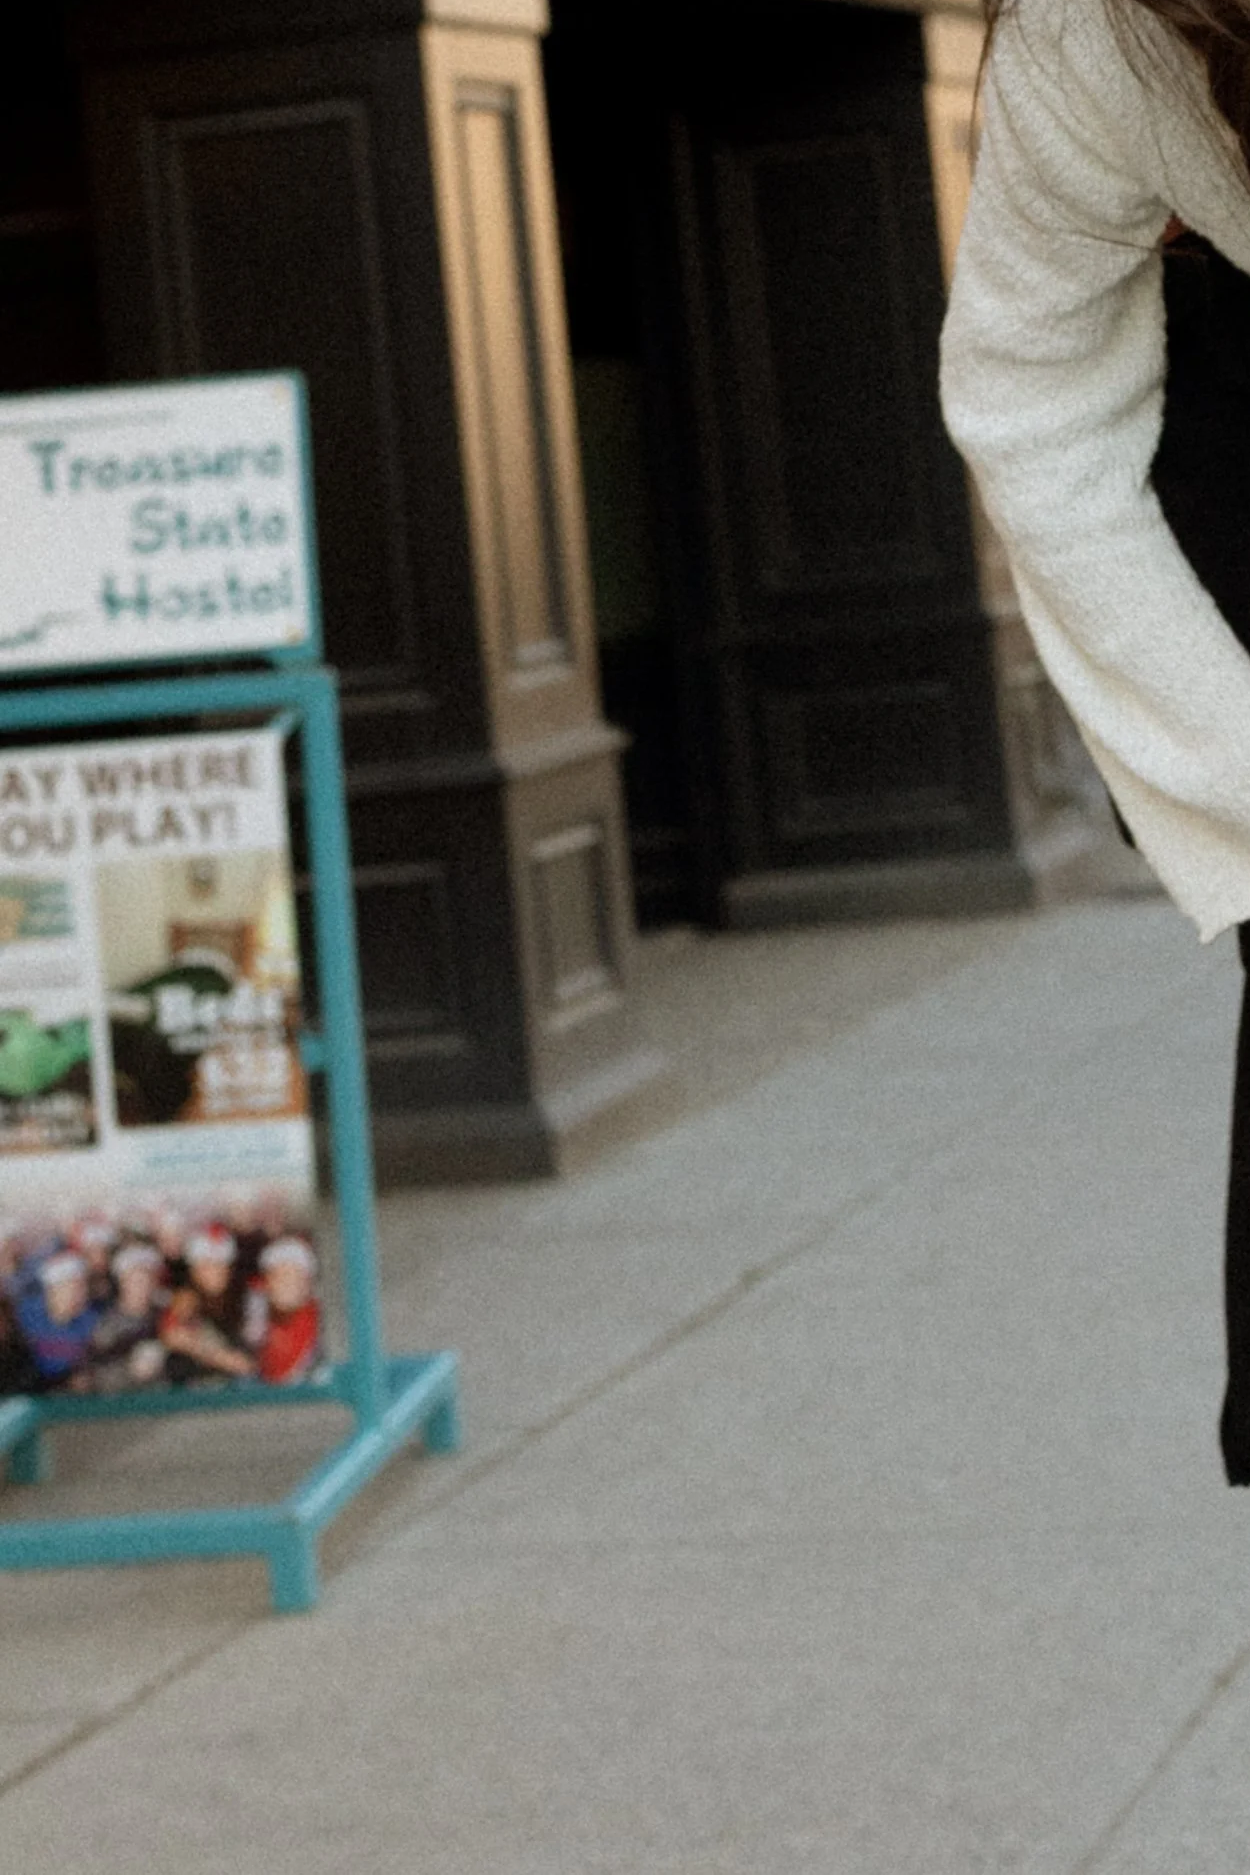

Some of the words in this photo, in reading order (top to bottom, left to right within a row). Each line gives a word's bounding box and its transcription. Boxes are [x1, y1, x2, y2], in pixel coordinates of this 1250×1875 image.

[30, 436, 285, 495] Treasure
[129, 497, 287, 555] State
[100, 563, 294, 619] Hostel
[79, 743, 254, 798] WHERE
